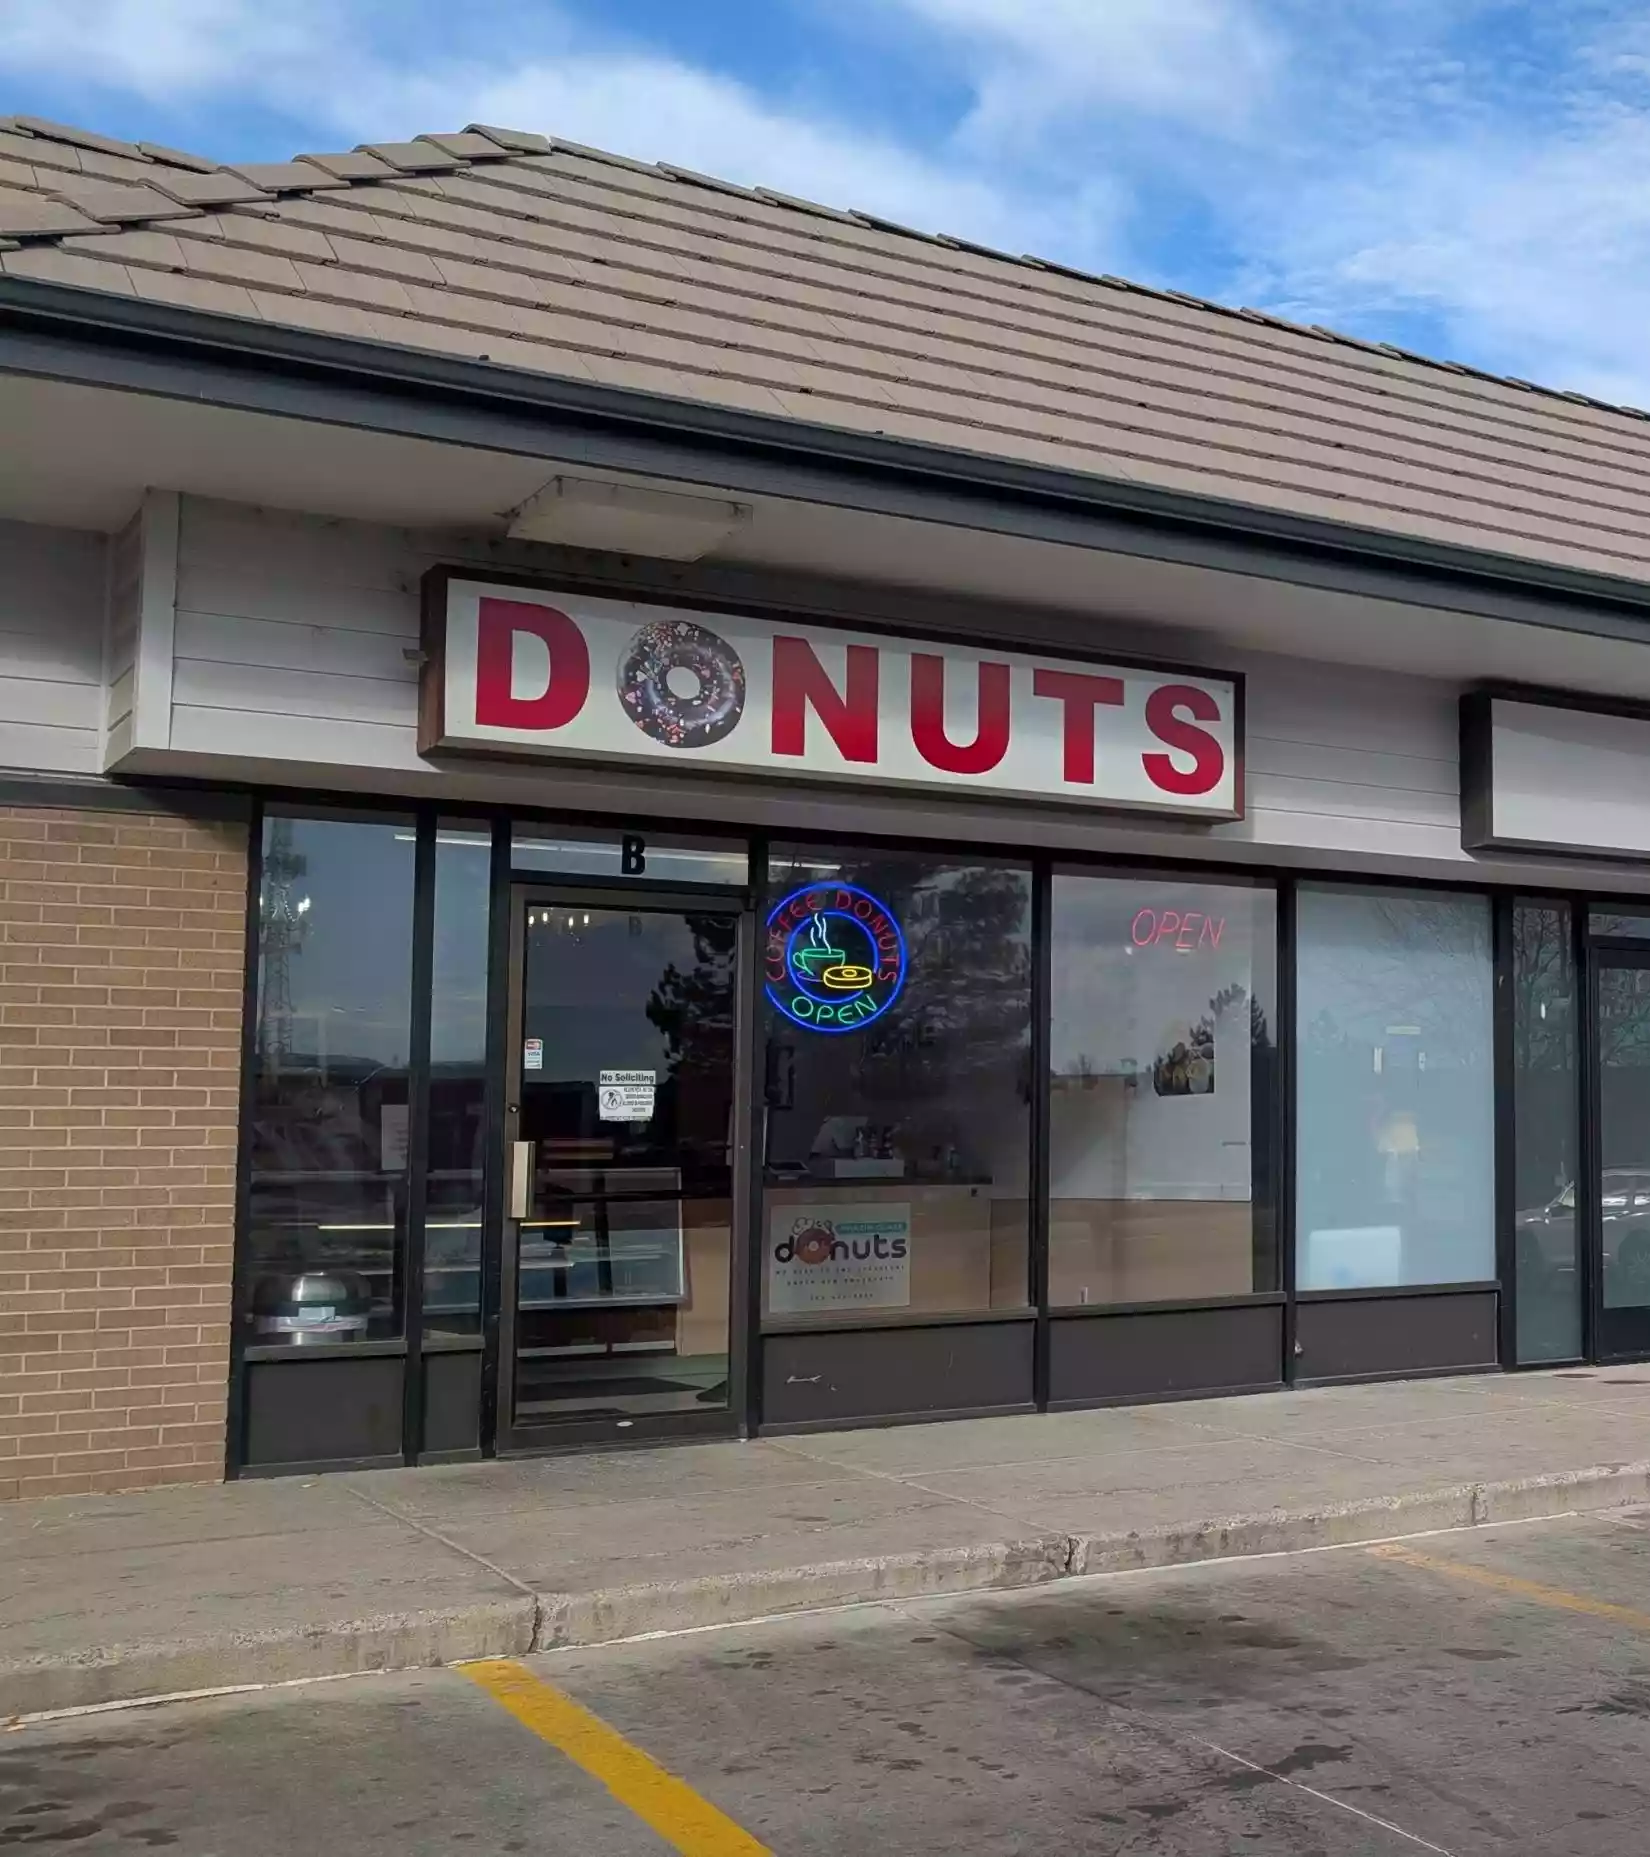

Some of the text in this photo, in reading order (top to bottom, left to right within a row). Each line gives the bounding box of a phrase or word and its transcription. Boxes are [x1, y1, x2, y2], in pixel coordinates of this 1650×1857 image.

[475, 597, 1224, 795] DONUTS
[622, 835, 646, 875] B
[764, 890, 900, 984] COFFEE DONUTS
[1132, 908, 1226, 949] OPEN
[791, 993, 879, 1025] OPEN
[601, 1072, 654, 1084] No Soliciting
[774, 1230, 907, 1264] donuts
